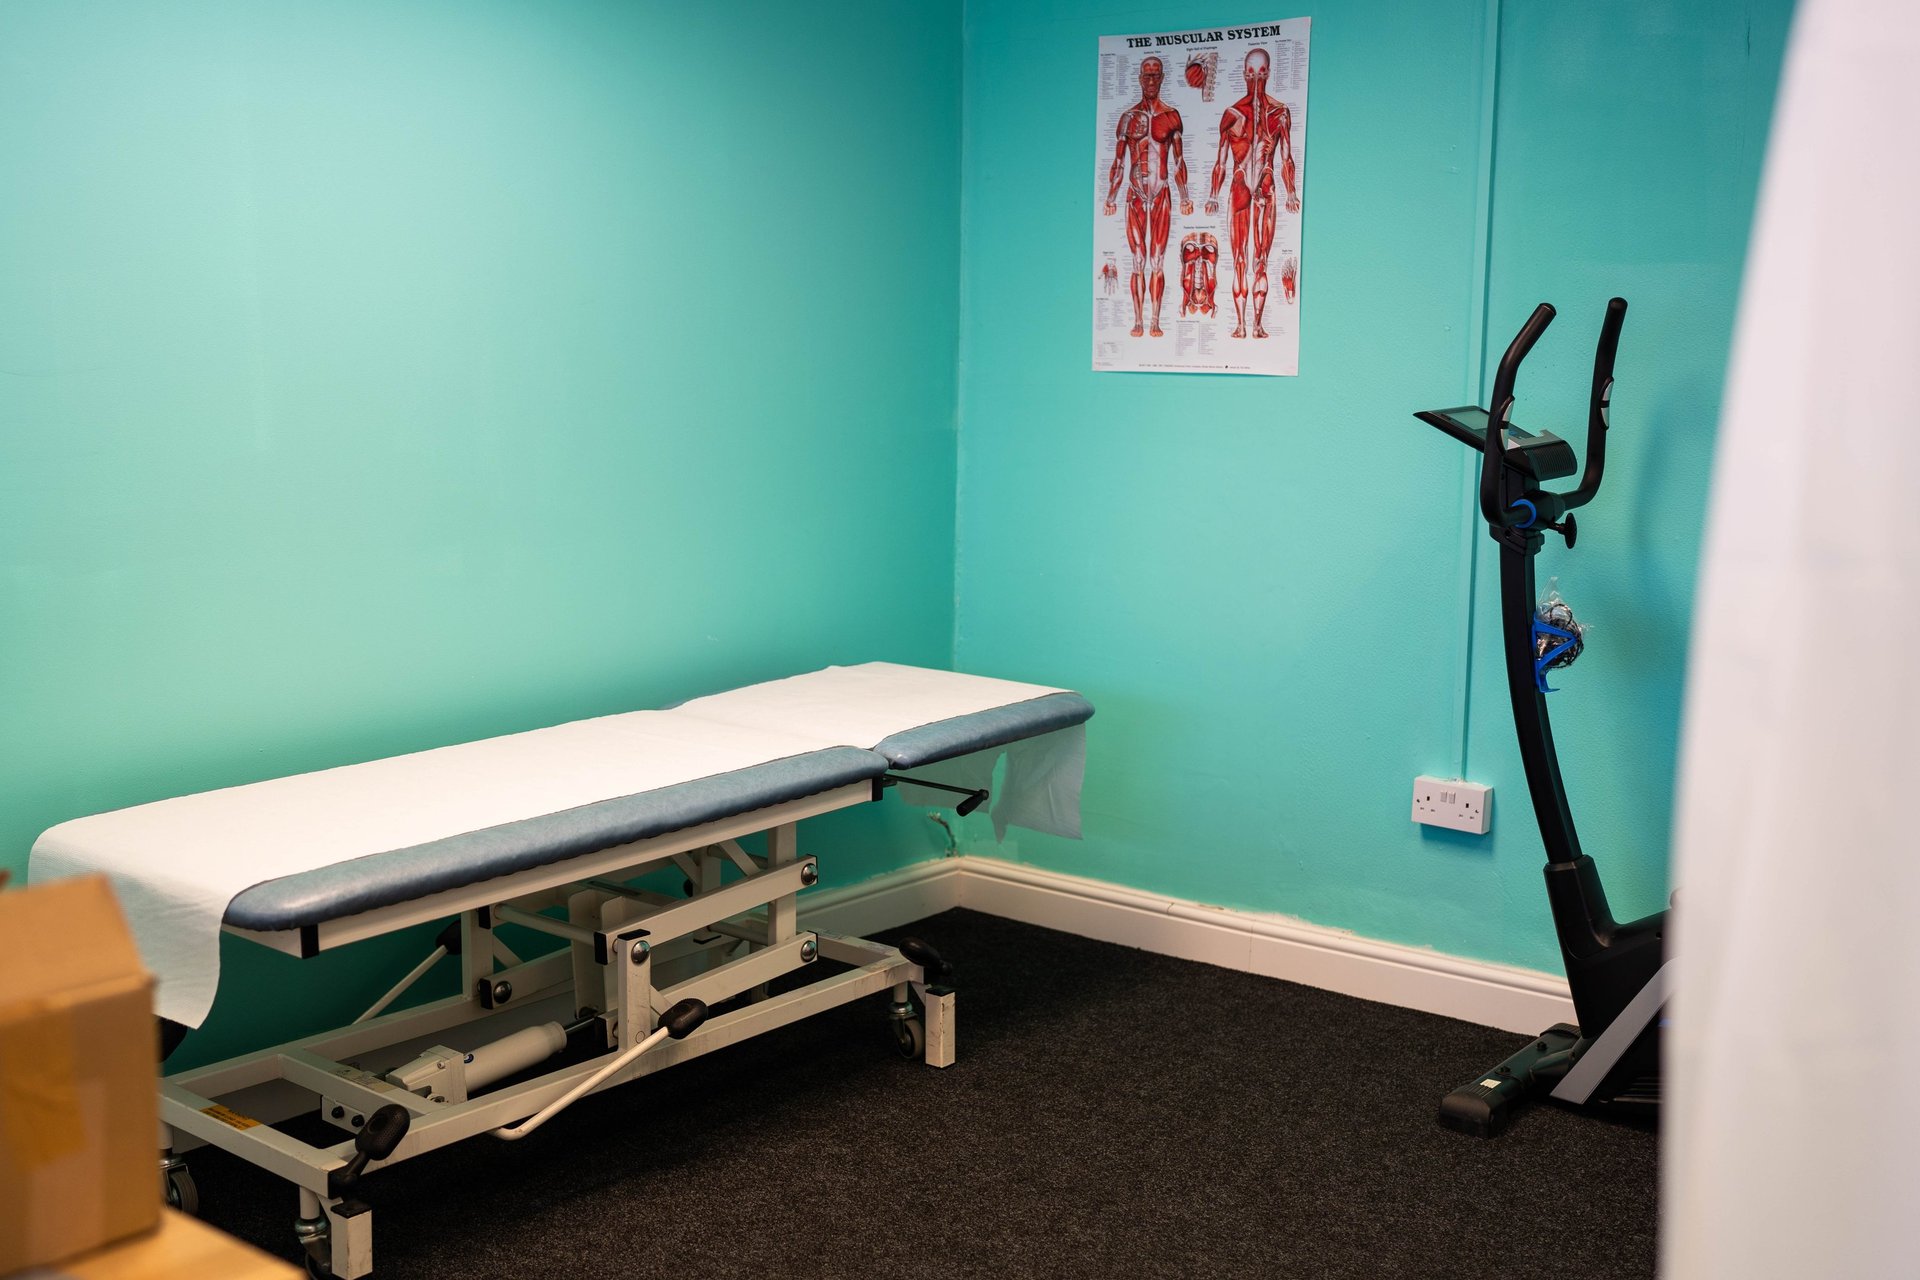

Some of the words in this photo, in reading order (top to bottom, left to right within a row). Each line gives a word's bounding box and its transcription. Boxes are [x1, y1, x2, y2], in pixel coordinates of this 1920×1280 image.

[1127, 37, 1152, 48] THE
[1156, 32, 1224, 46] MUSCULAR
[1228, 25, 1280, 40] SYSTEM
